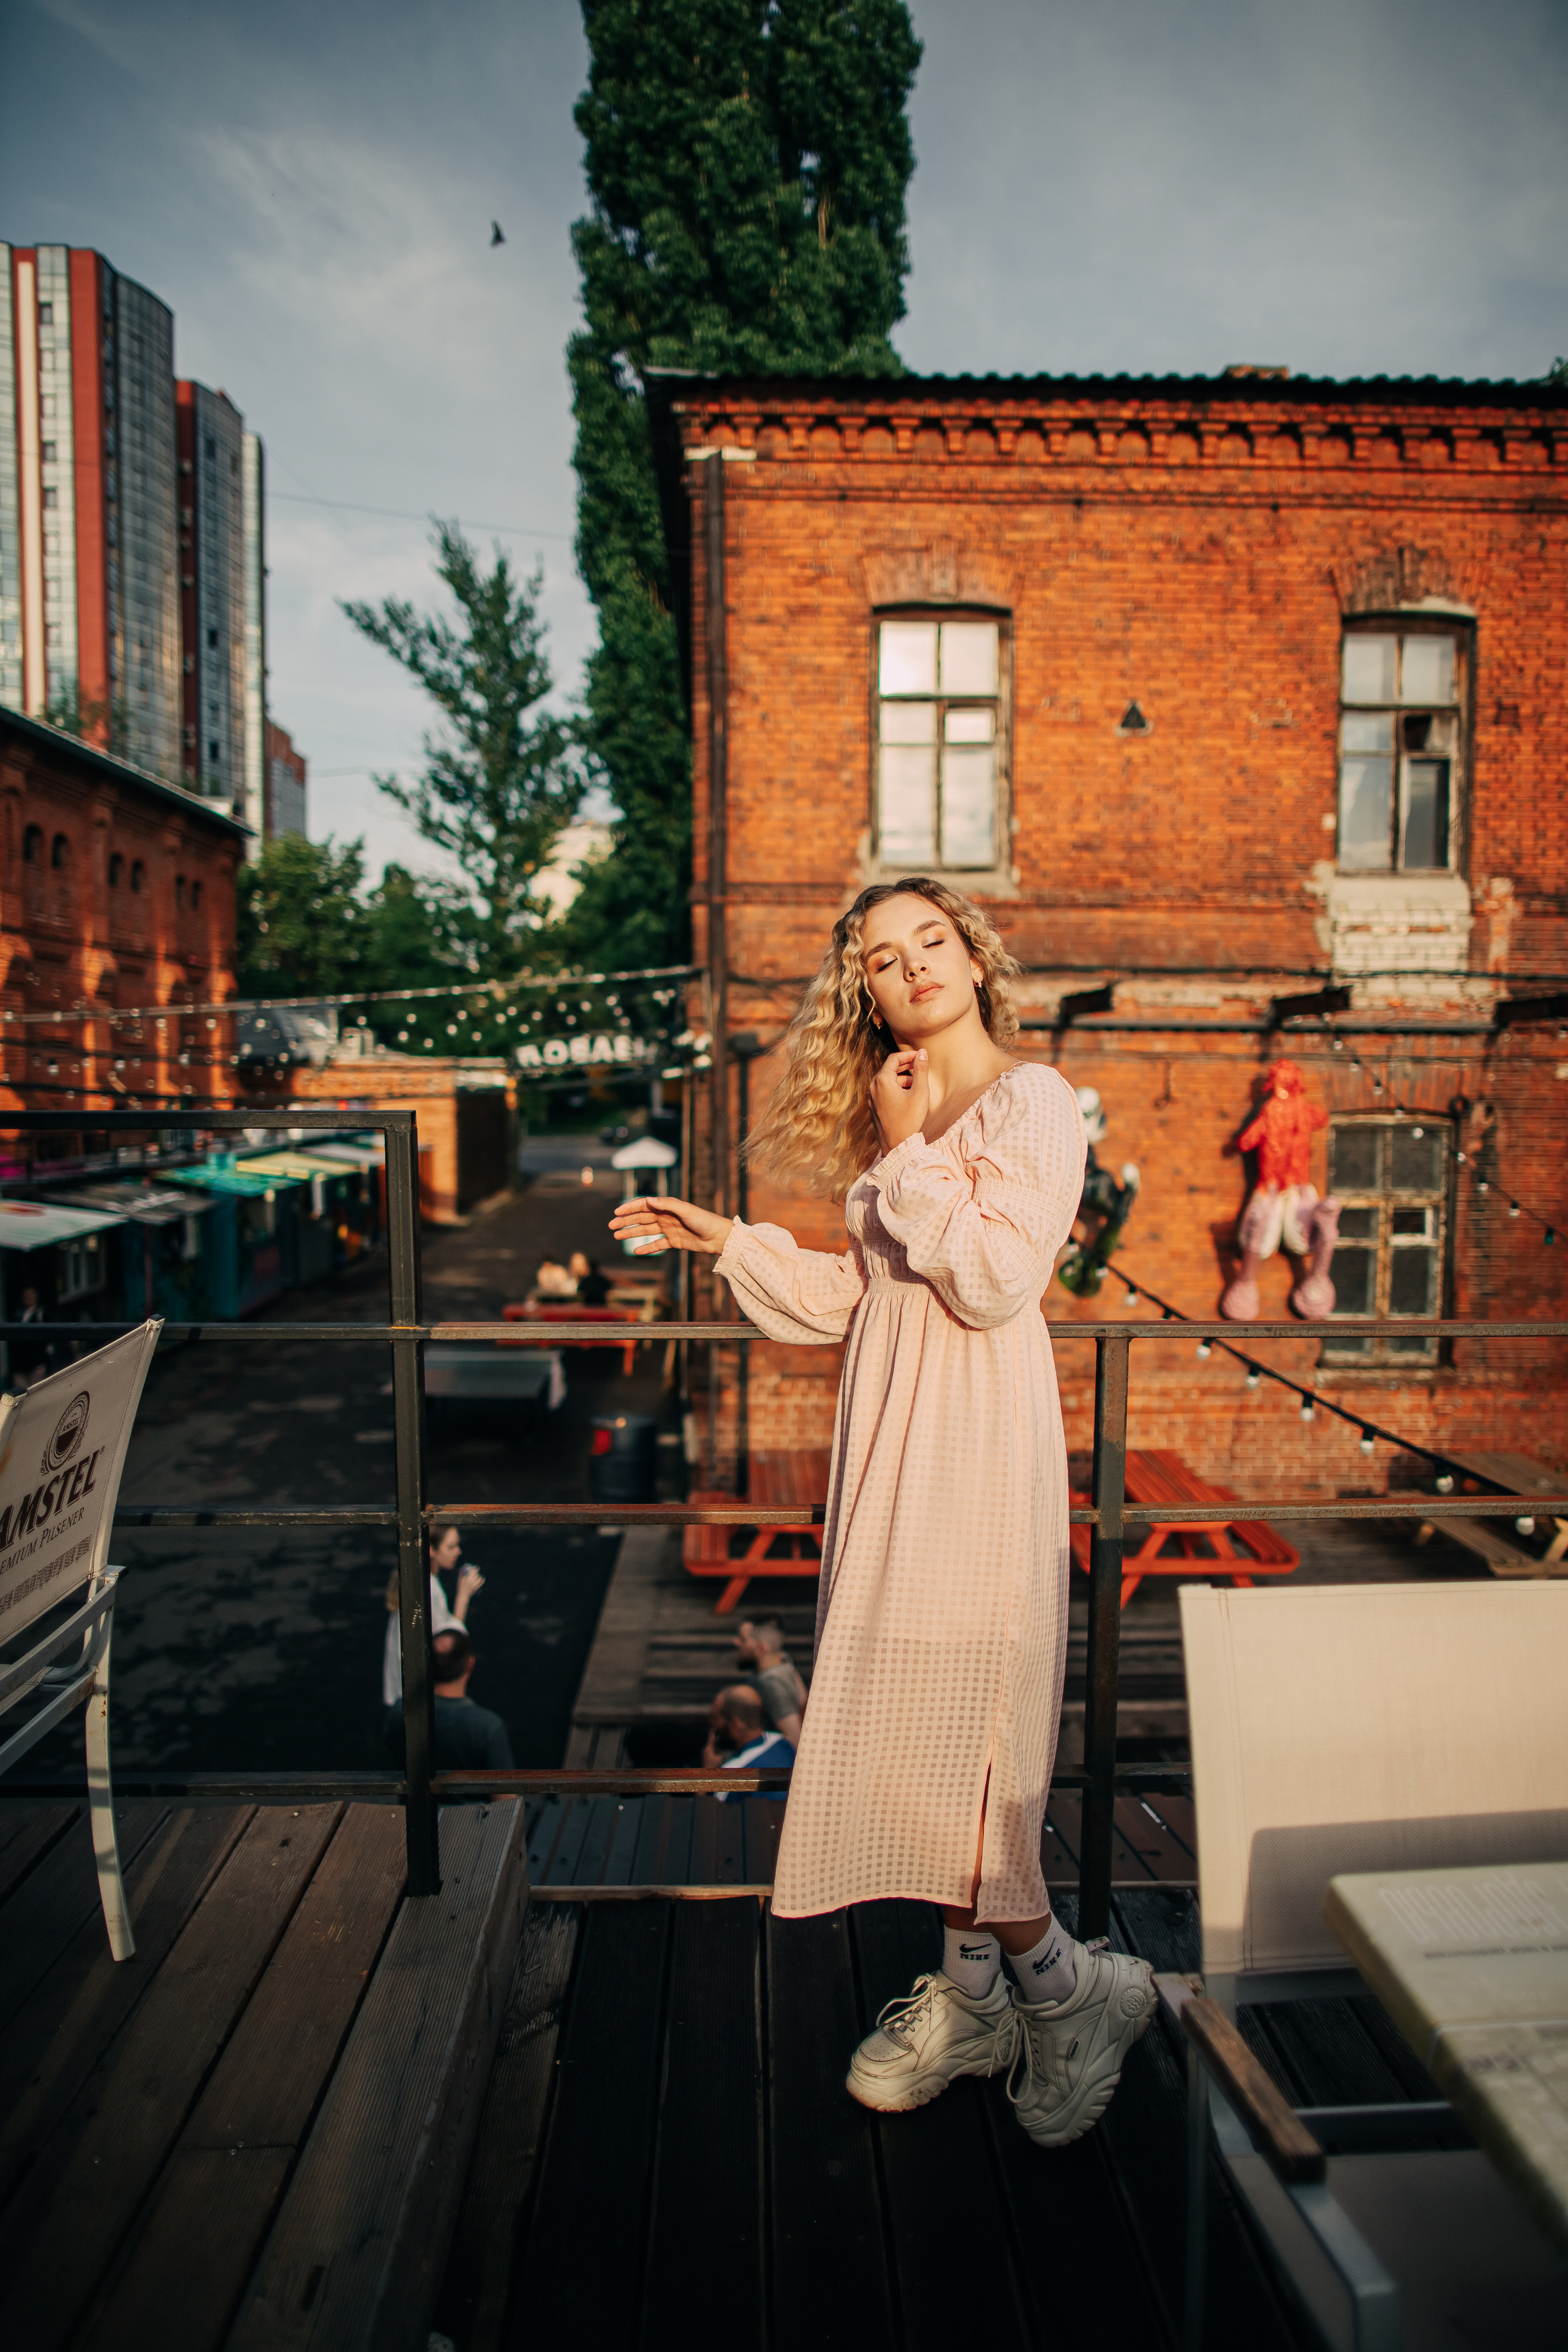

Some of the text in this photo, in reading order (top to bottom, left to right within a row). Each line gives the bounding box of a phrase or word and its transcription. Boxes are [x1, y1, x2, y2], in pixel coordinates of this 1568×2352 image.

[0, 1449, 100, 1552] AMSTEL
[39, 1507, 85, 1549] PILSENER
[1035, 1948, 1061, 1976] NIKE
